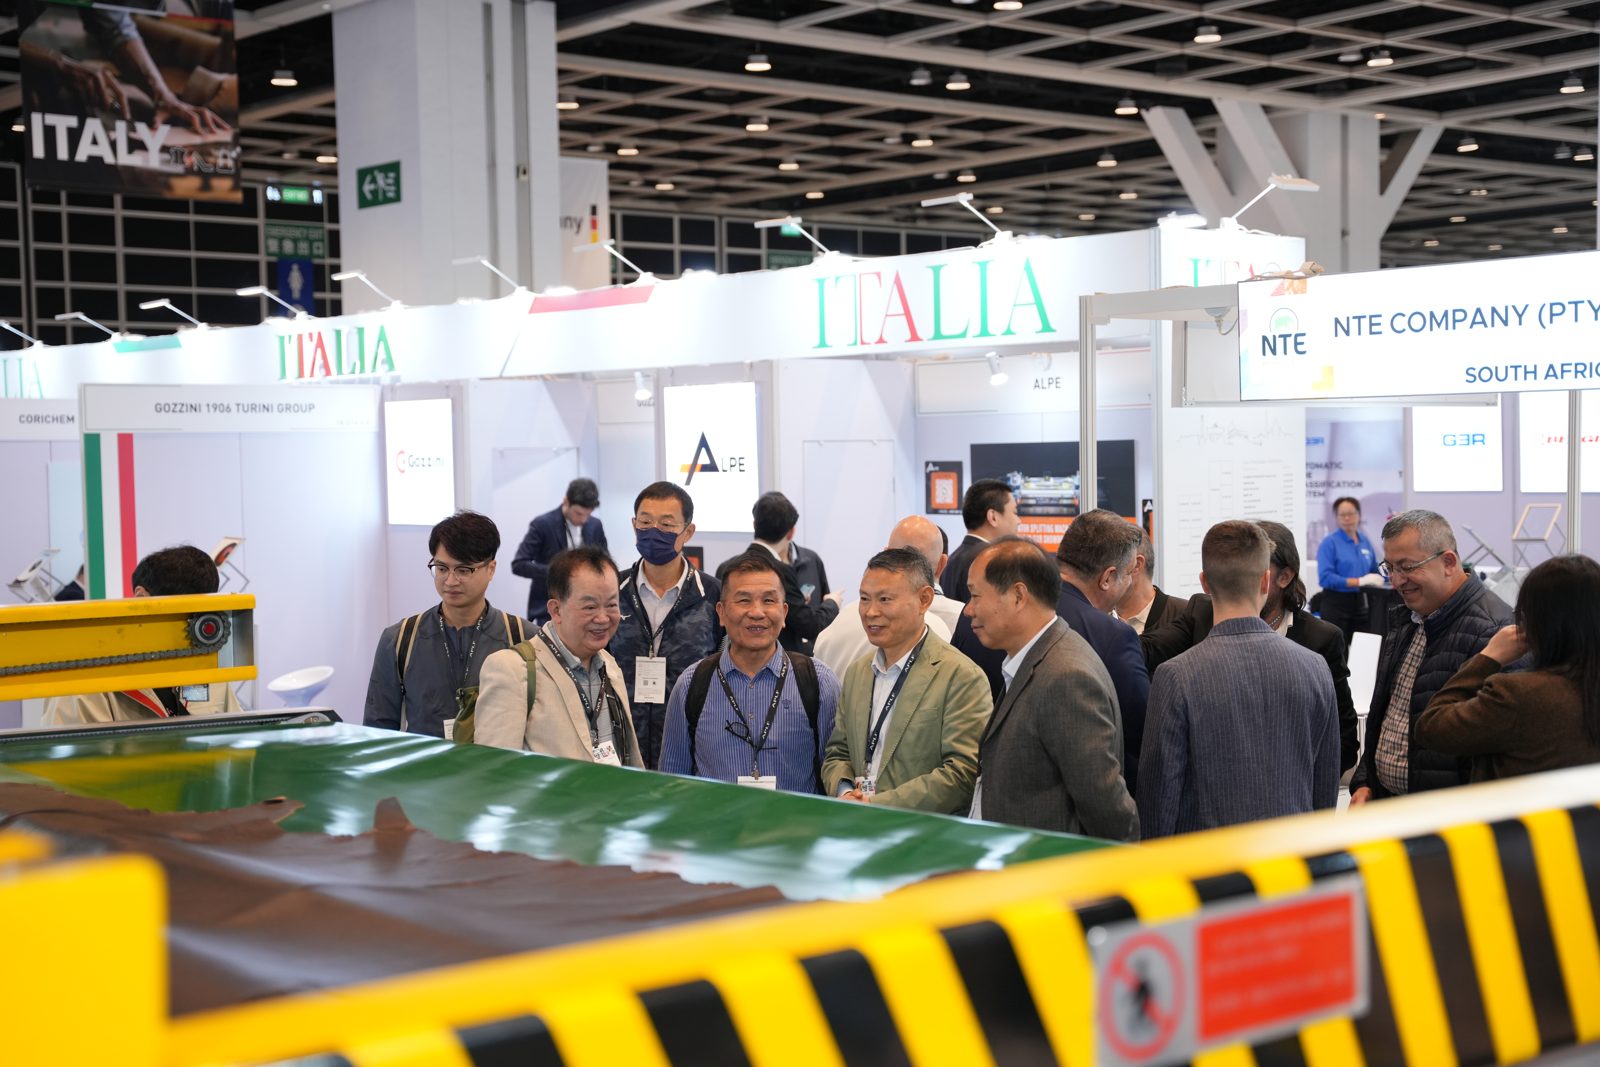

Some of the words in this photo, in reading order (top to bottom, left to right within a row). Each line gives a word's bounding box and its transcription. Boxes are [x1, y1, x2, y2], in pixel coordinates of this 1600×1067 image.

[31, 112, 171, 167] ITALY
[560, 215, 583, 235] ny
[812, 256, 1057, 349] ITALIA
[1334, 314, 1383, 338] NTE
[1390, 303, 1529, 334] COMPANY
[1538, 299, 1600, 330] (PTY
[277, 324, 396, 380] ITALIA
[1261, 333, 1307, 356] NTE
[1033, 377, 1062, 390] ALPE
[1465, 364, 1537, 383] SOUTH
[154, 402, 202, 414] GOZZINI
[206, 402, 232, 414] 1906
[235, 402, 274, 414] TURINI
[277, 402, 316, 414] GROUP
[19, 414, 75, 425] CORICHEM
